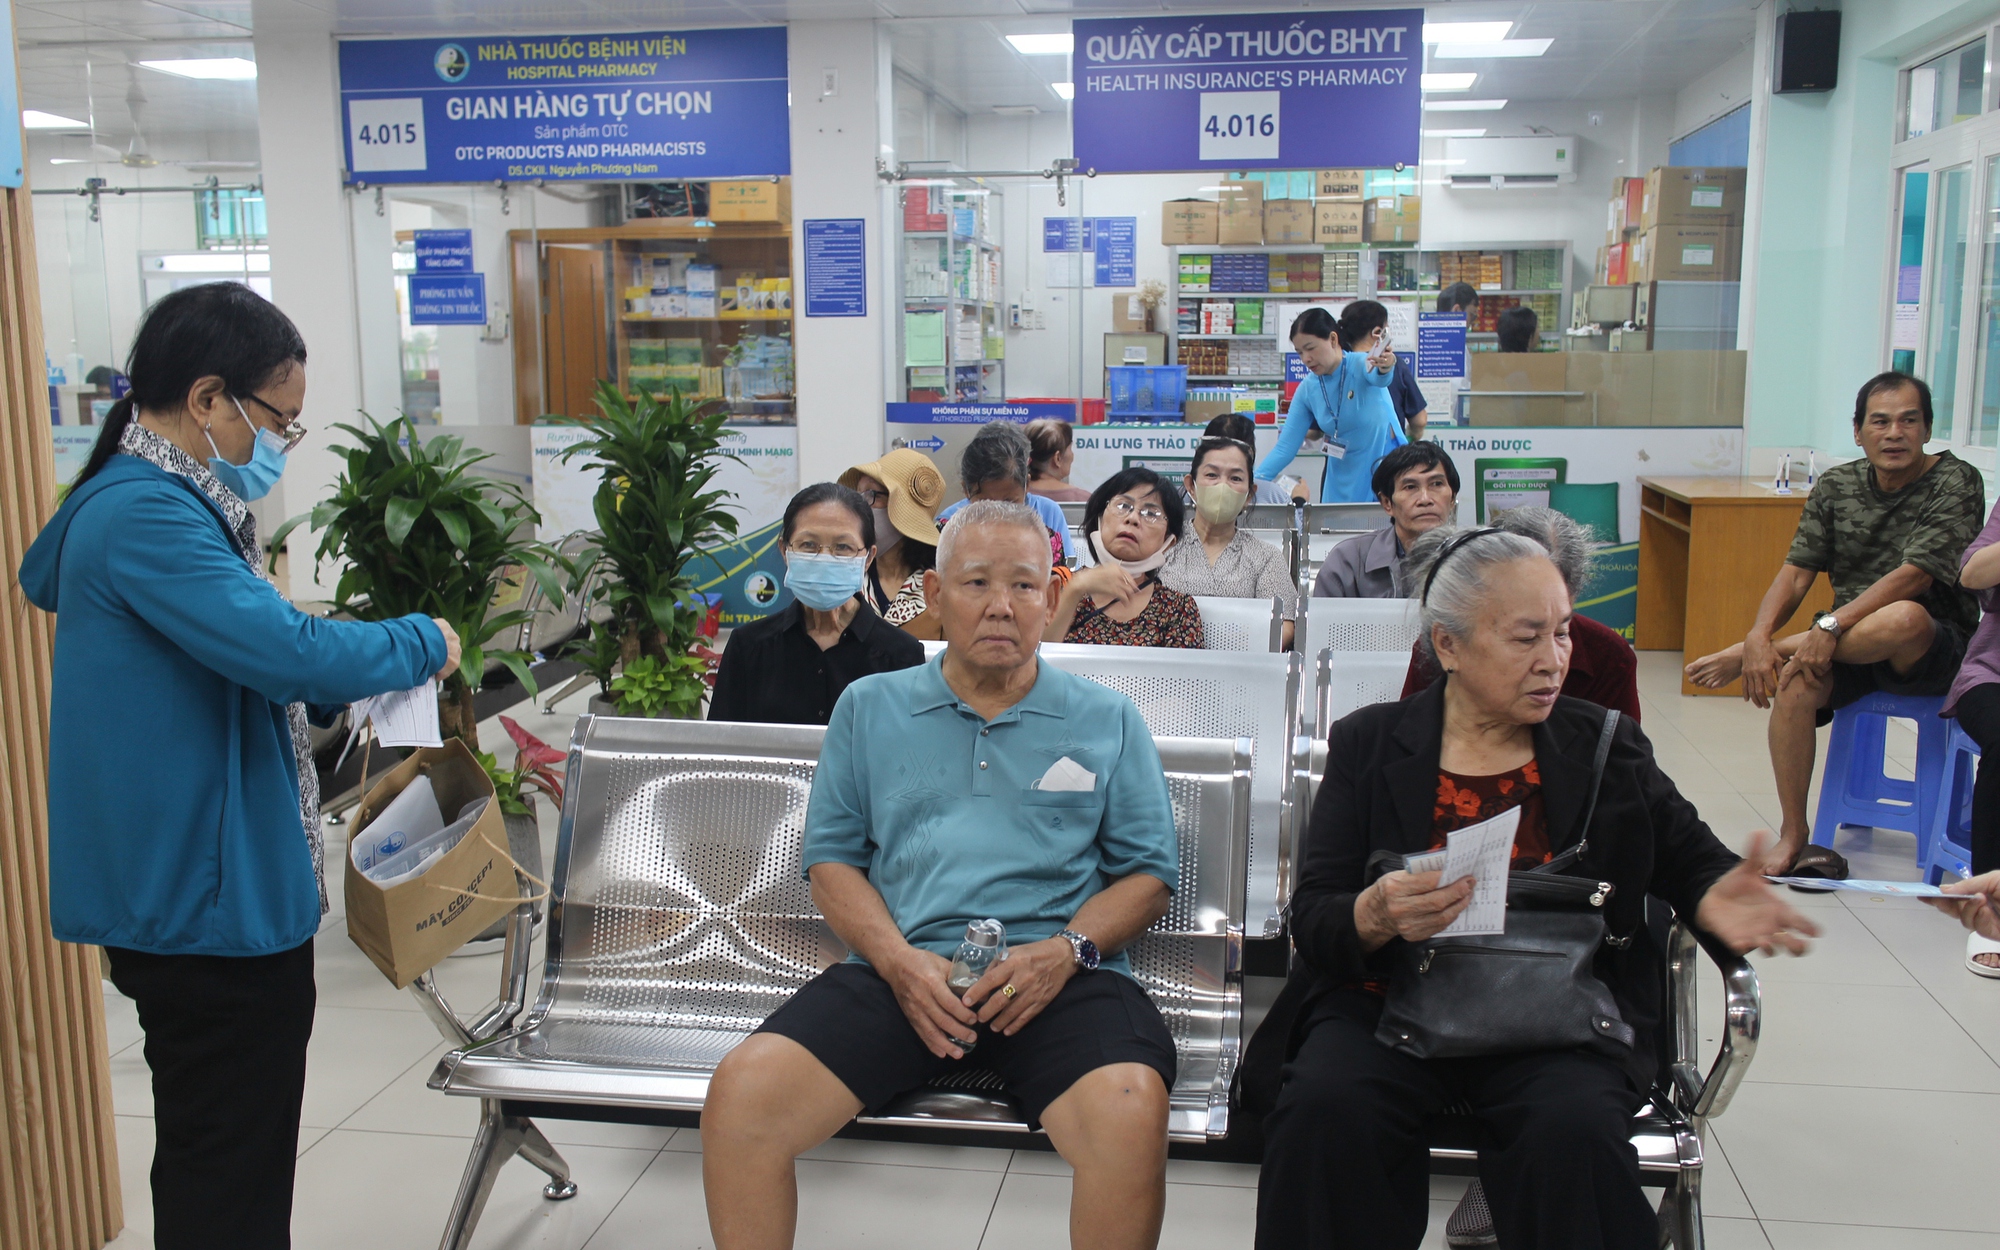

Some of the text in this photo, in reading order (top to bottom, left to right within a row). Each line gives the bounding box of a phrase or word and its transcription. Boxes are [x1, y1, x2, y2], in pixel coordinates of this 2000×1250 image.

[478, 36, 686, 61] NHÀ THUỐC BỆNH VIỆN
[1086, 20, 1407, 63] QUẦY CẤP THUỐC BHYT
[507, 63, 658, 80] HOSPITAL PHARMACY
[1086, 68, 1408, 92] HEALTH INSURANCE'S PHARMACY
[446, 90, 712, 122] GIAN HÀNG TỰ CHỌN
[359, 123, 416, 145] 4.015
[534, 124, 628, 141] Sản phẩm OTC
[1205, 113, 1275, 138] 4.016
[455, 142, 707, 161] OTC PRODUCTS AND PHARMACISTS
[550, 162, 590, 177] Nguyễn
[633, 163, 658, 174] Nam
[932, 406, 958, 415] KHÔNG
[959, 406, 980, 416] PHẬN
[1014, 406, 1029, 415] VÀO
[1076, 438, 1098, 449] ĐAI
[1104, 438, 1142, 449] LƯNG
[1147, 434, 1185, 449] THẢO
[1449, 436, 1486, 450] THẢO
[1491, 440, 1532, 454] DƯỢC
[535, 448, 560, 456] MINH
[738, 448, 762, 456] MINH
[765, 448, 793, 458] MẠNG
[416, 909, 444, 932] MÂY
